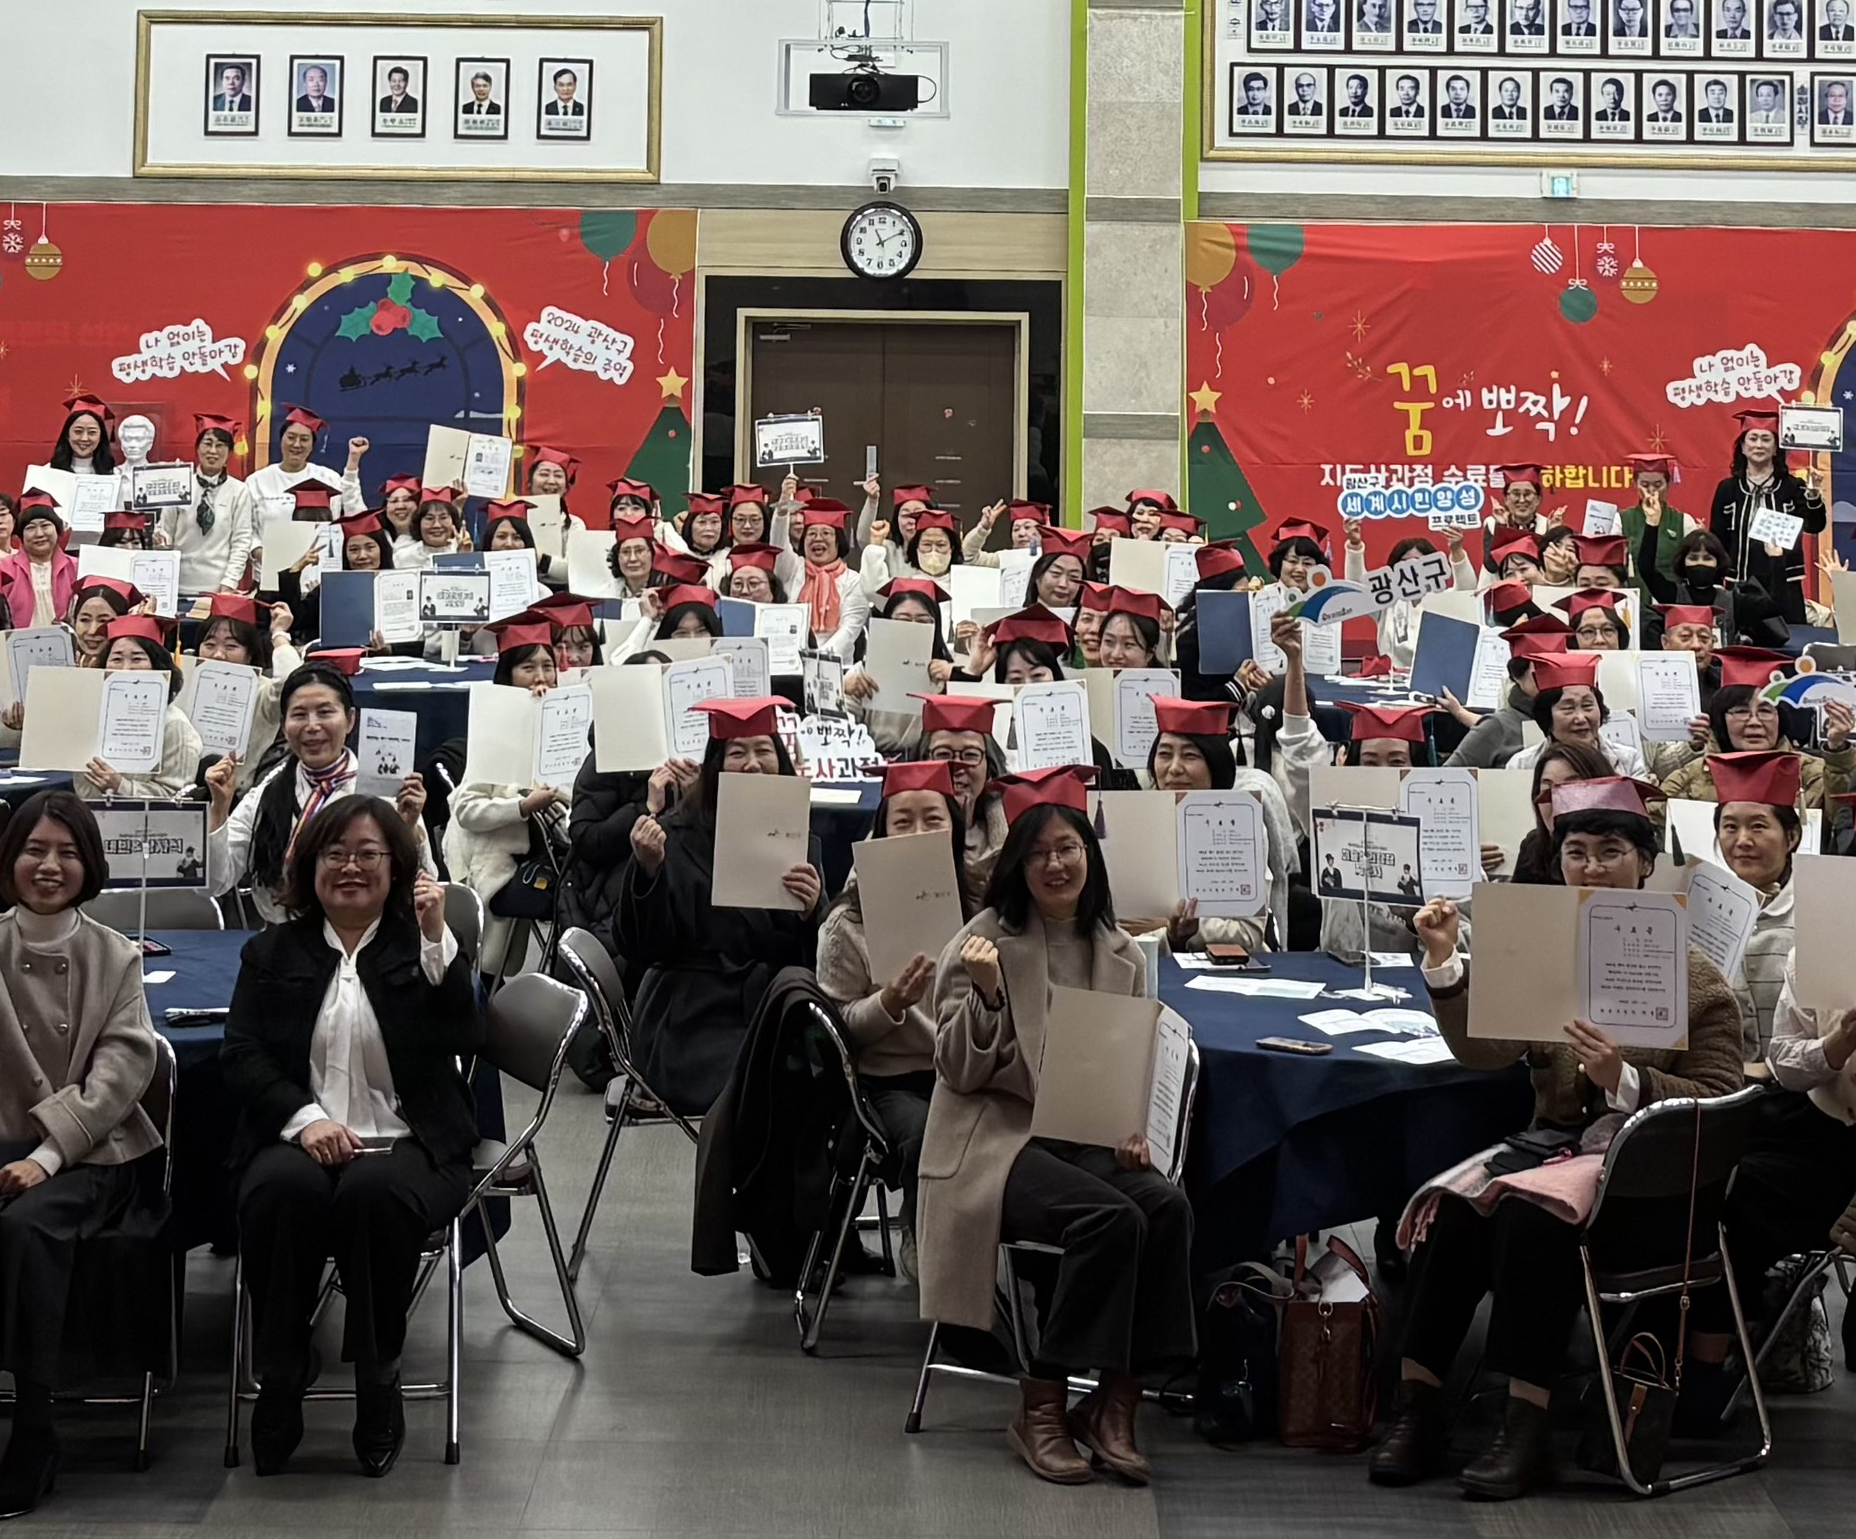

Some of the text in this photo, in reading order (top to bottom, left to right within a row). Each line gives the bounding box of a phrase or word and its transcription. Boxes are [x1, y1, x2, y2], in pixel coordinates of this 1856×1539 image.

[146, 325, 206, 349] 나 없이는
[547, 312, 628, 356] 2024 광산구
[118, 352, 176, 376] 평생학습
[530, 328, 627, 378] 평생학습의 주역
[1699, 350, 1760, 373] 나 없이는
[1673, 378, 1731, 401] 평생학습
[1387, 362, 1588, 456] 꿈에 뽀짝!
[1541, 466, 1633, 489] 하합니다
[1345, 487, 1480, 513] 세계시민양성
[1432, 514, 1478, 527] 프로젝트
[1369, 558, 1447, 604] 광산구
